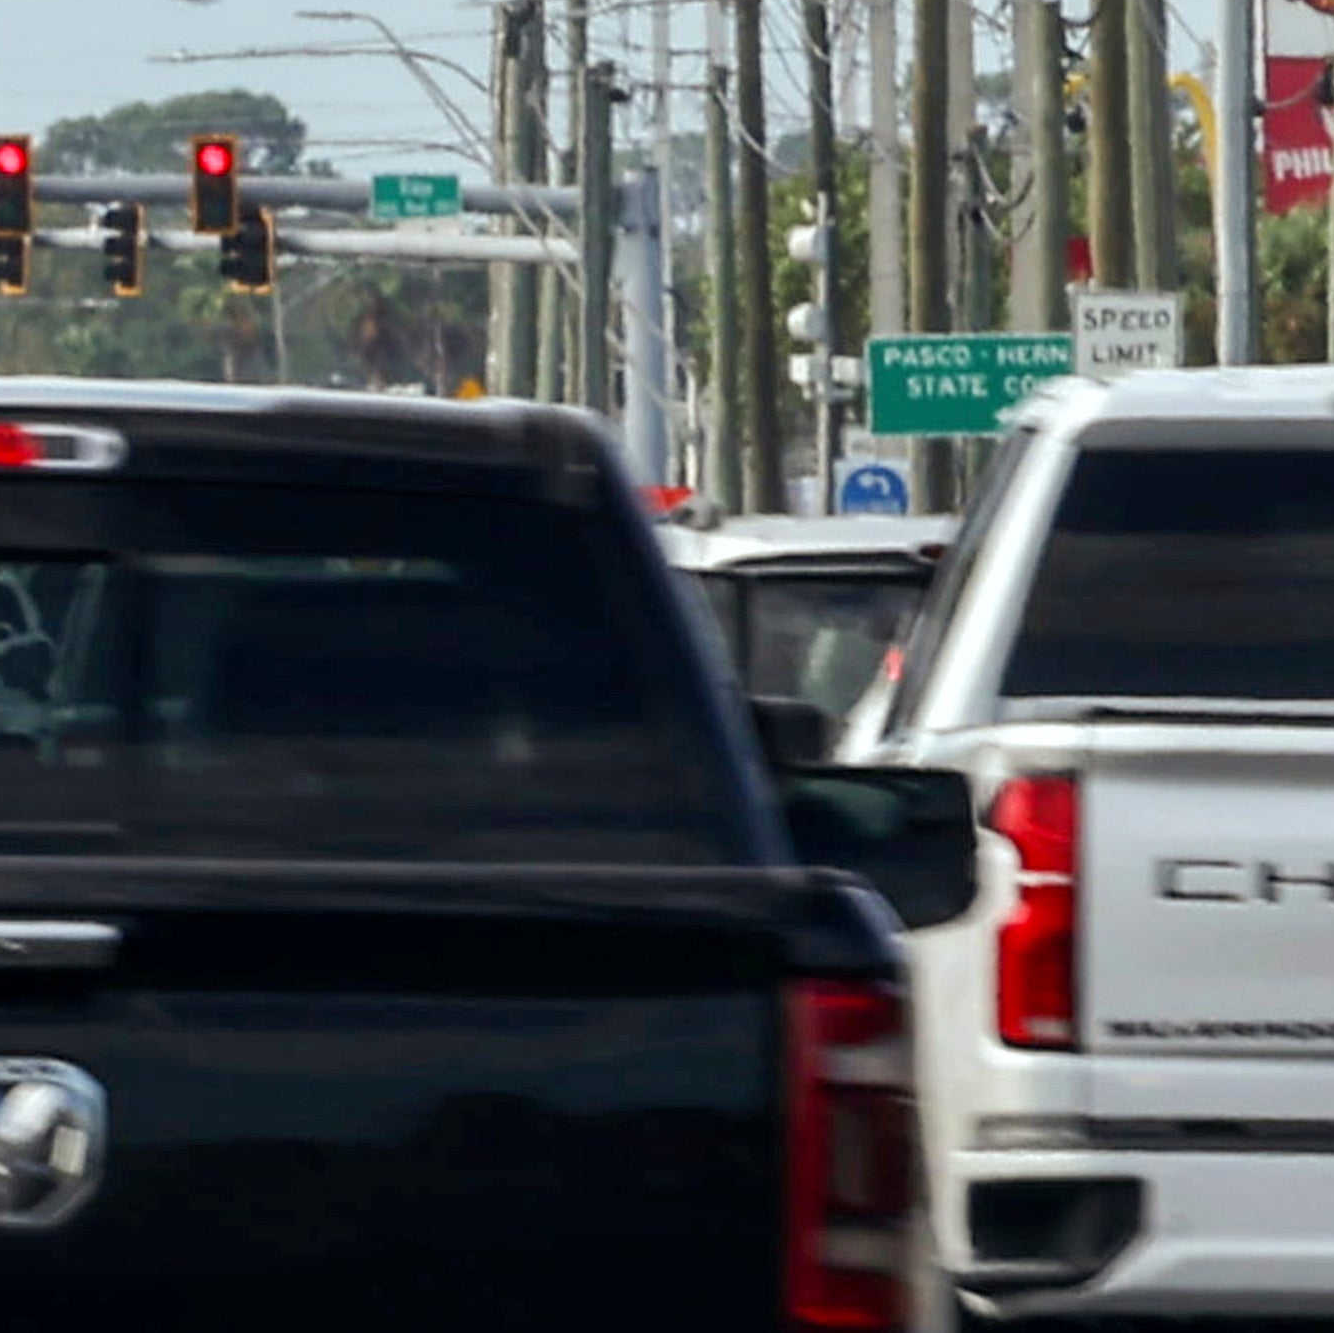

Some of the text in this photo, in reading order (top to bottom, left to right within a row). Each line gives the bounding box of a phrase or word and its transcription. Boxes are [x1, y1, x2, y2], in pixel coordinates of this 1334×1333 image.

[1083, 308, 1171, 331] SPEED
[883, 346, 971, 368] PASCO
[996, 344, 1068, 366] HERN
[1091, 343, 1158, 365] LIMIT
[906, 374, 988, 400] STATE
